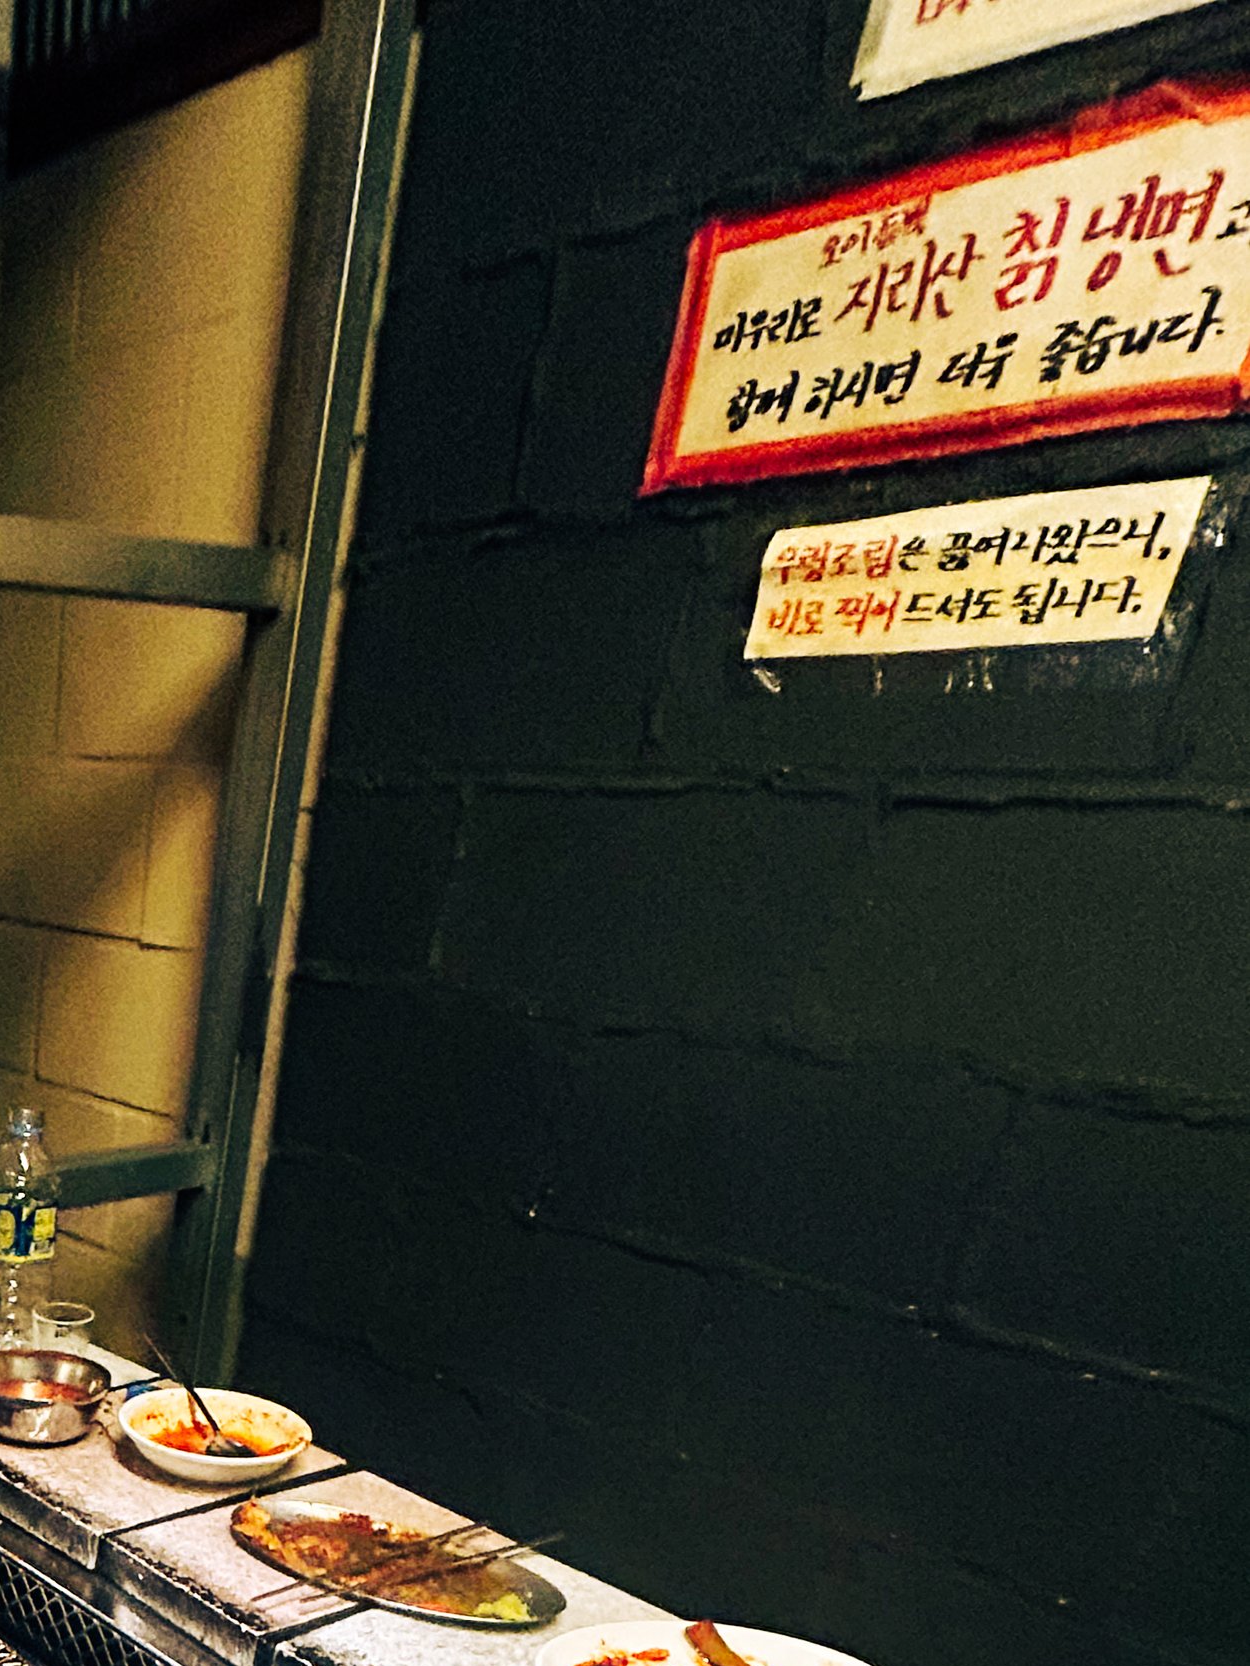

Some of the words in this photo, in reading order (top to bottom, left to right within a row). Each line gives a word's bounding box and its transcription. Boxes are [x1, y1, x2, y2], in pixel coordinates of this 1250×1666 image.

[835, 233, 983, 332] 지리산
[768, 597, 824, 636] 바로
[1010, 575, 1143, 625] 됩니다.
